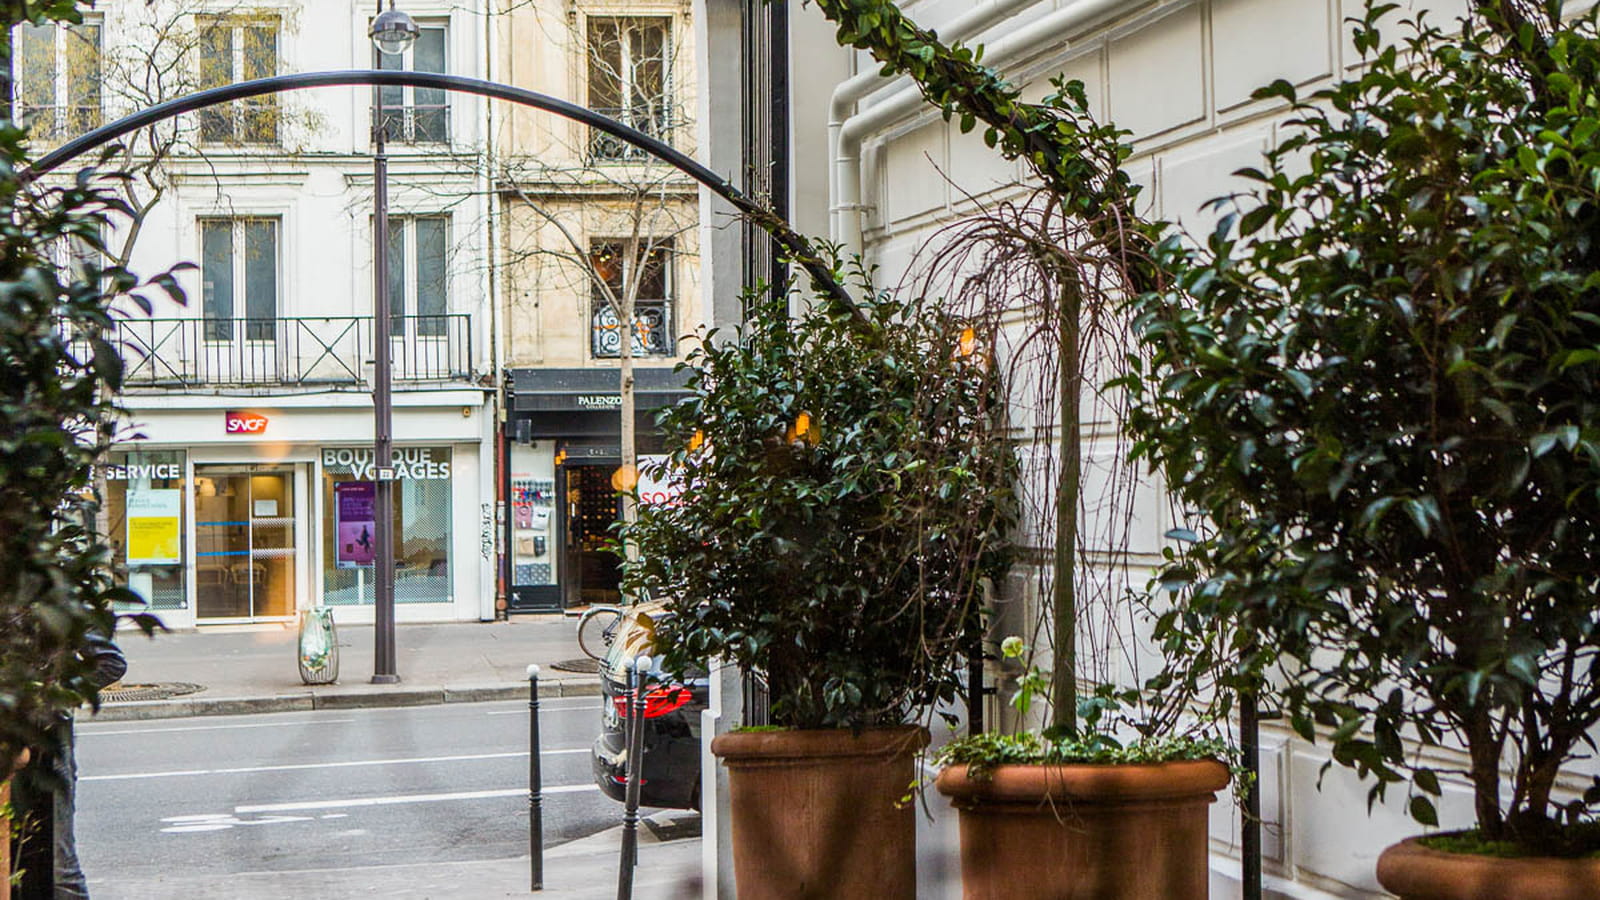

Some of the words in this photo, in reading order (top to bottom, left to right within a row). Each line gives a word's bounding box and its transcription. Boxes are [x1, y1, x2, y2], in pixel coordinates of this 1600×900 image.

[228, 418, 265, 431] SNCF
[323, 448, 432, 465] BOUTQUE
[106, 464, 180, 480] SERVICE
[350, 461, 450, 480] VOAGES
